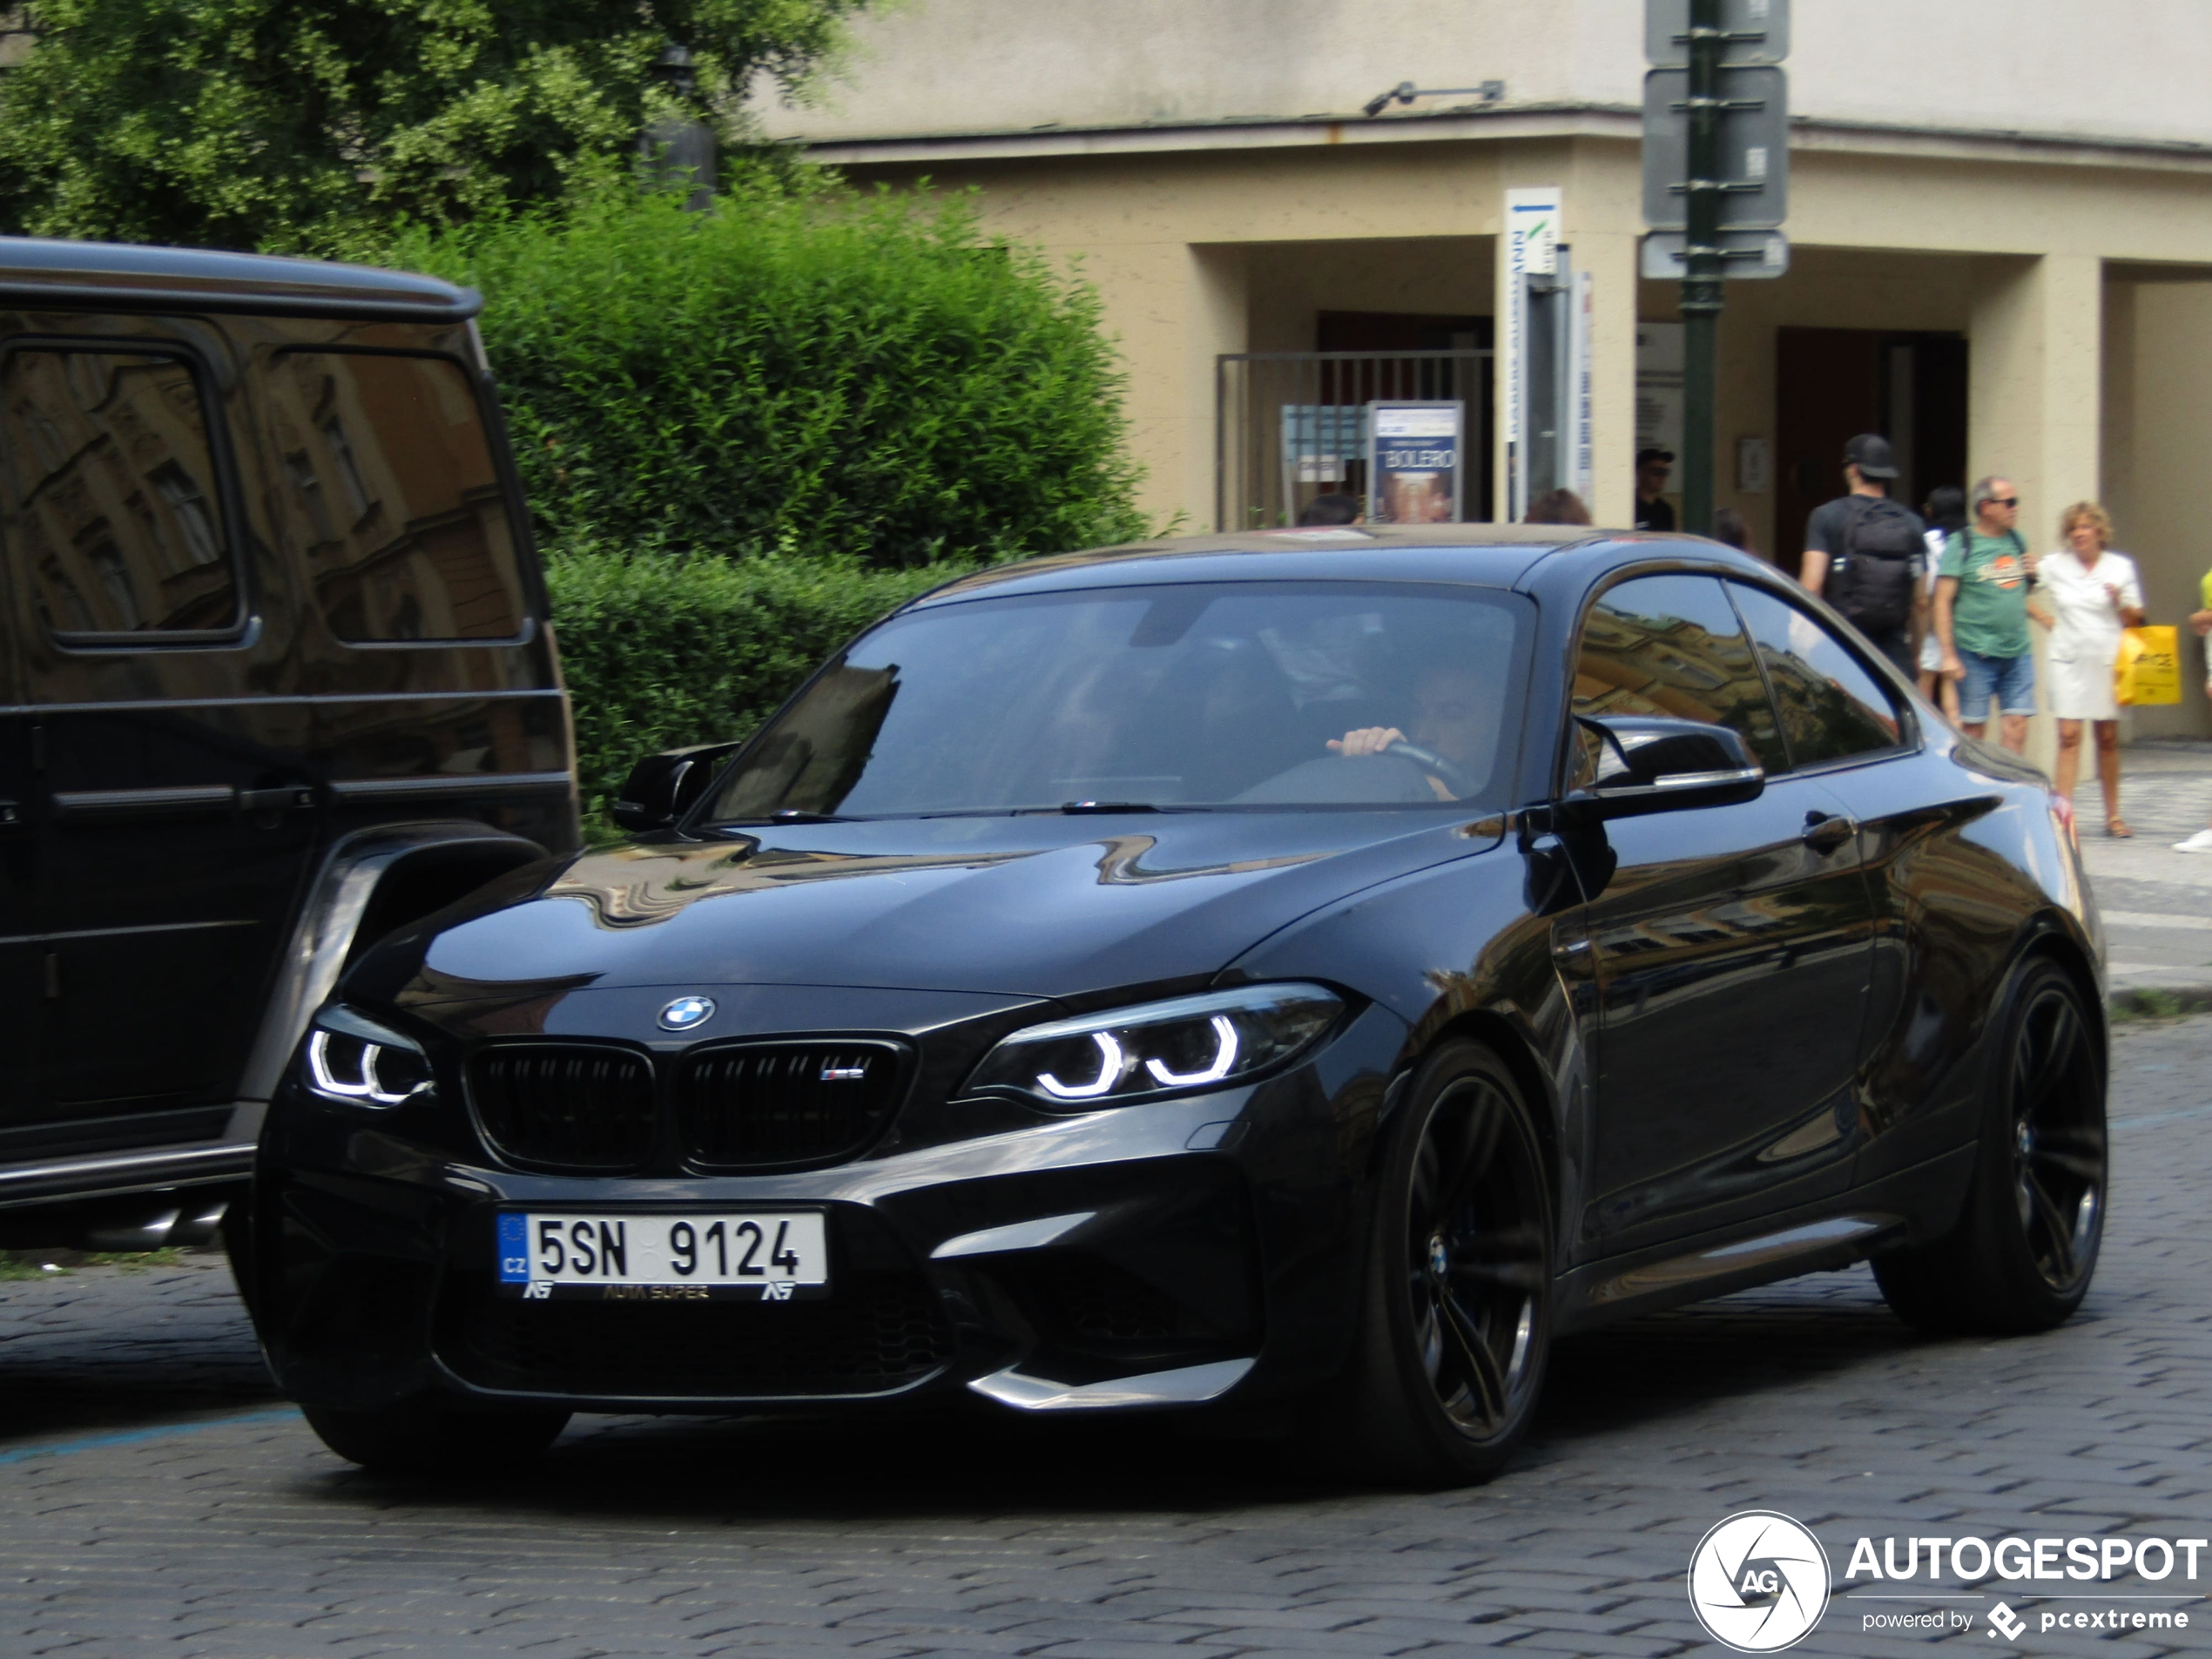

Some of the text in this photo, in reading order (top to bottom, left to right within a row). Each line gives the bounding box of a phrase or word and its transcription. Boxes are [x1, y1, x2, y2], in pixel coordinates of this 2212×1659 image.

[1385, 449, 1457, 469] BOLERO
[538, 1220, 799, 1276] 5SN 9124
[502, 1257, 527, 1273] CZ
